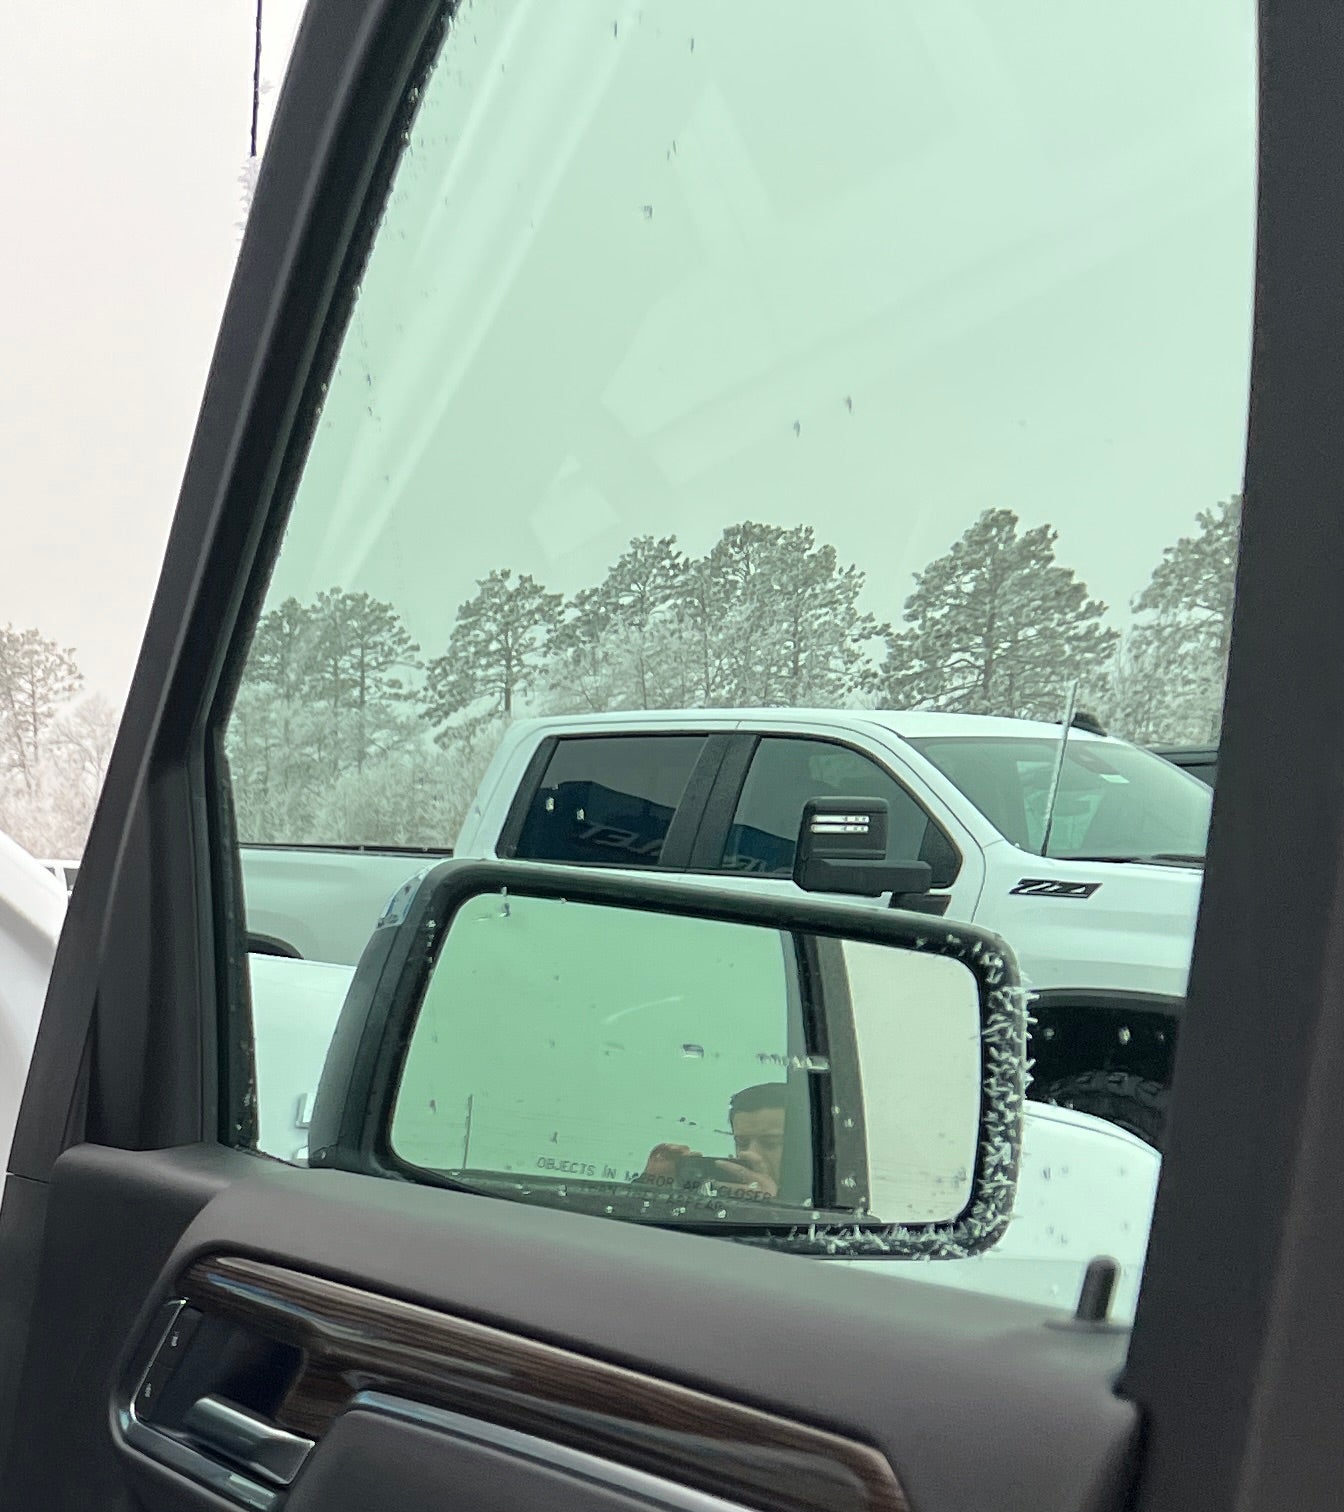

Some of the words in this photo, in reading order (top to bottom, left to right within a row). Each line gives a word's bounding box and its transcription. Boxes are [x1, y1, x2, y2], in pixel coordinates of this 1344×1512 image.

[536, 1156, 596, 1177] OBJECTS
[601, 1164, 617, 1180] IN
[718, 1184, 772, 1202] CLOSER
